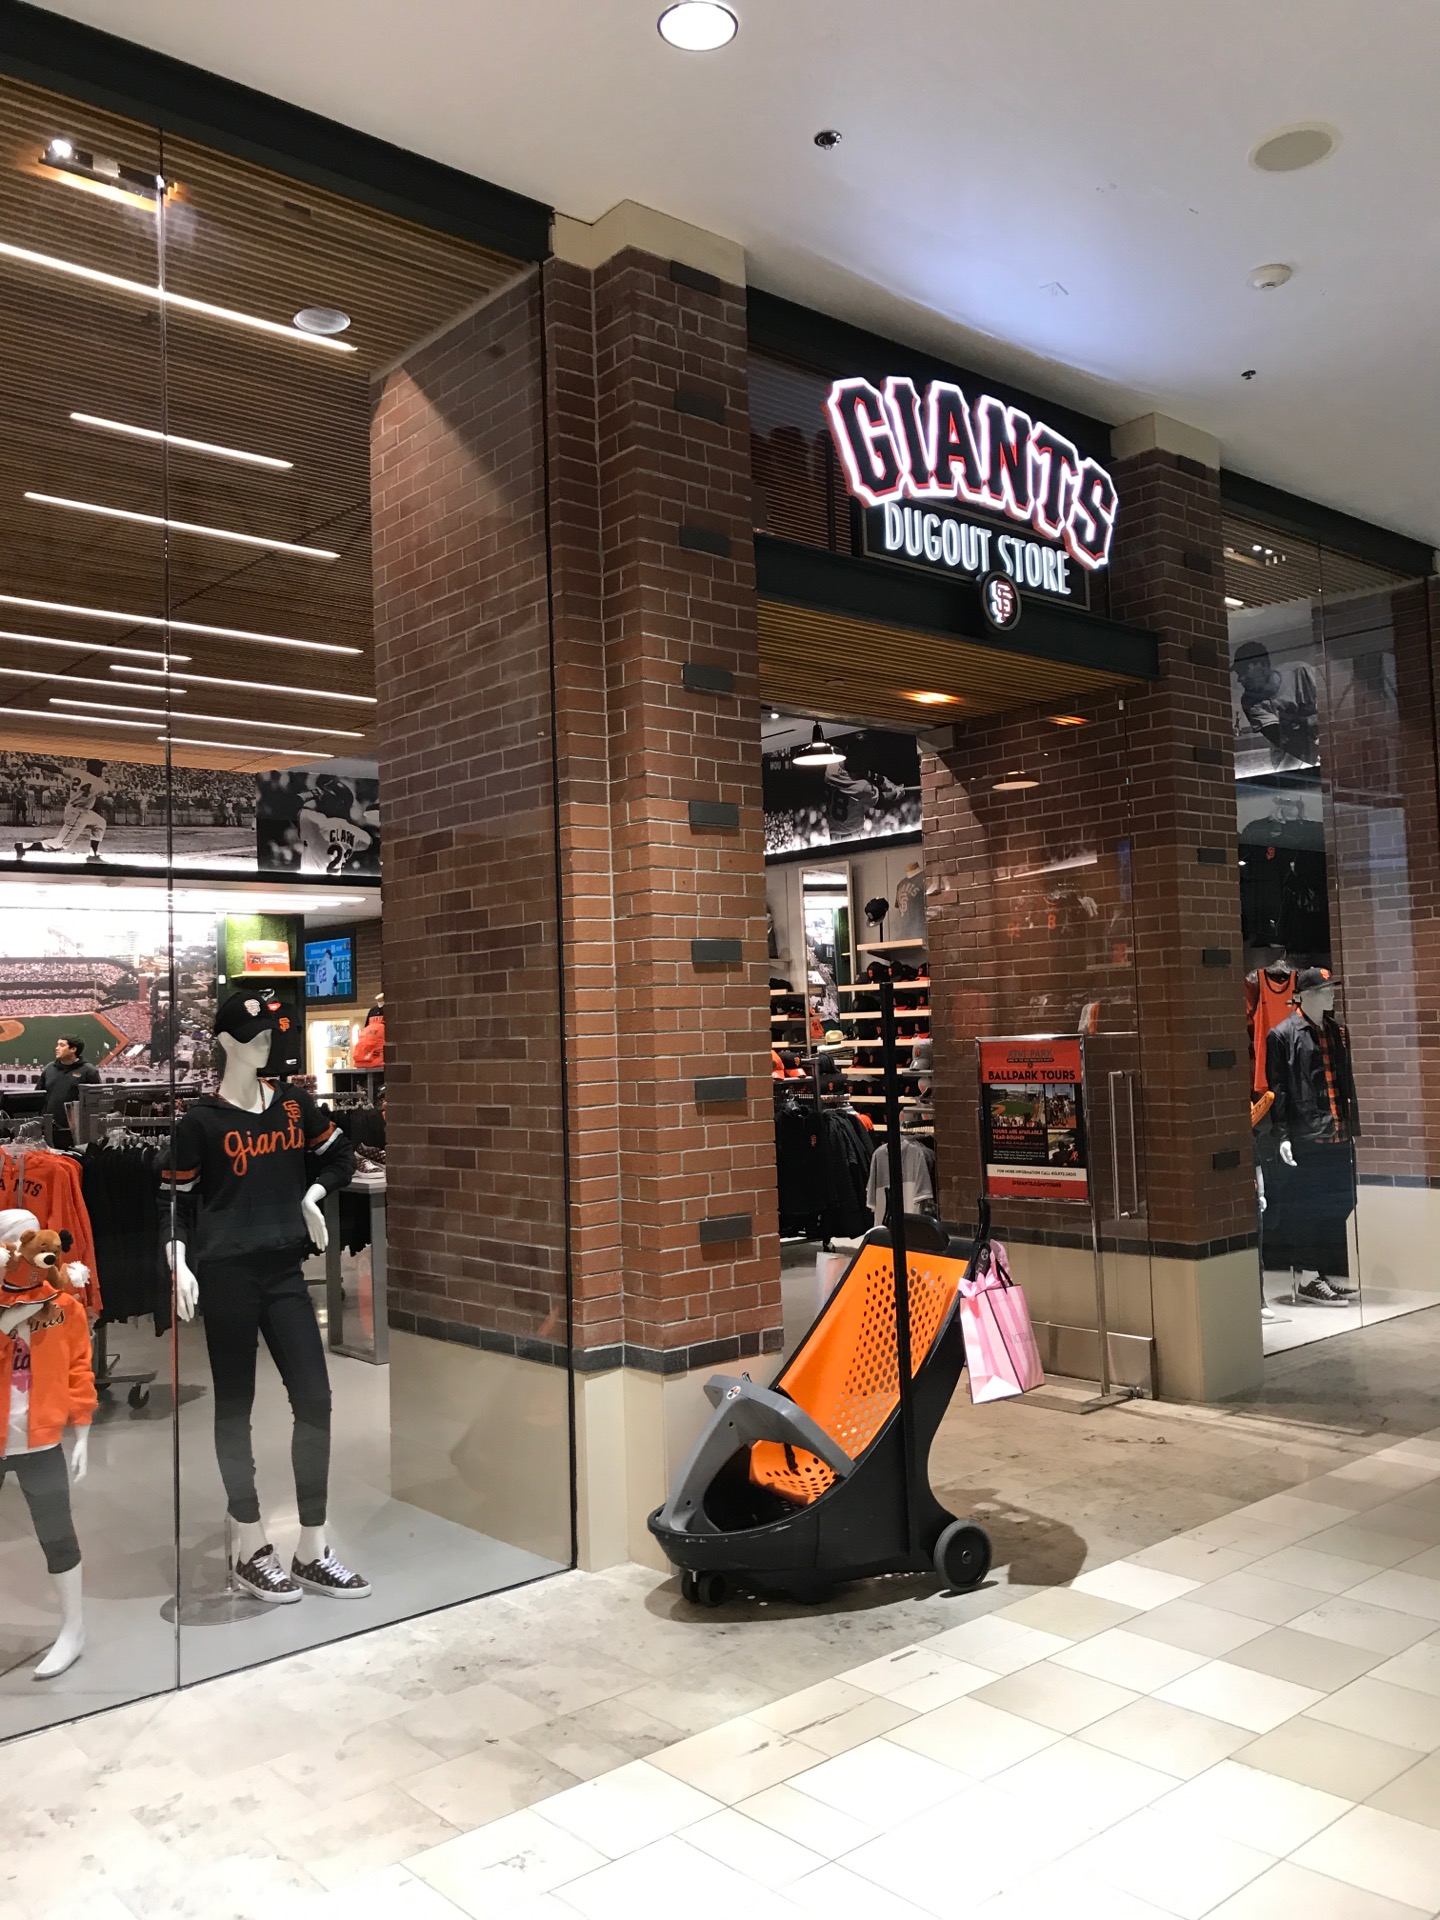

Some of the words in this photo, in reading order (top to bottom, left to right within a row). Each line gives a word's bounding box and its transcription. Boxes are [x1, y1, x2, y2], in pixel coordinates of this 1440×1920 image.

[824, 376, 1118, 570] GIANTS
[884, 501, 992, 572] DUGOUT
[998, 534, 1072, 594] STORE
[71, 776, 92, 798] 24
[988, 1070, 1038, 1080] BALLPARK
[1040, 1069, 1076, 1080] TOURS
